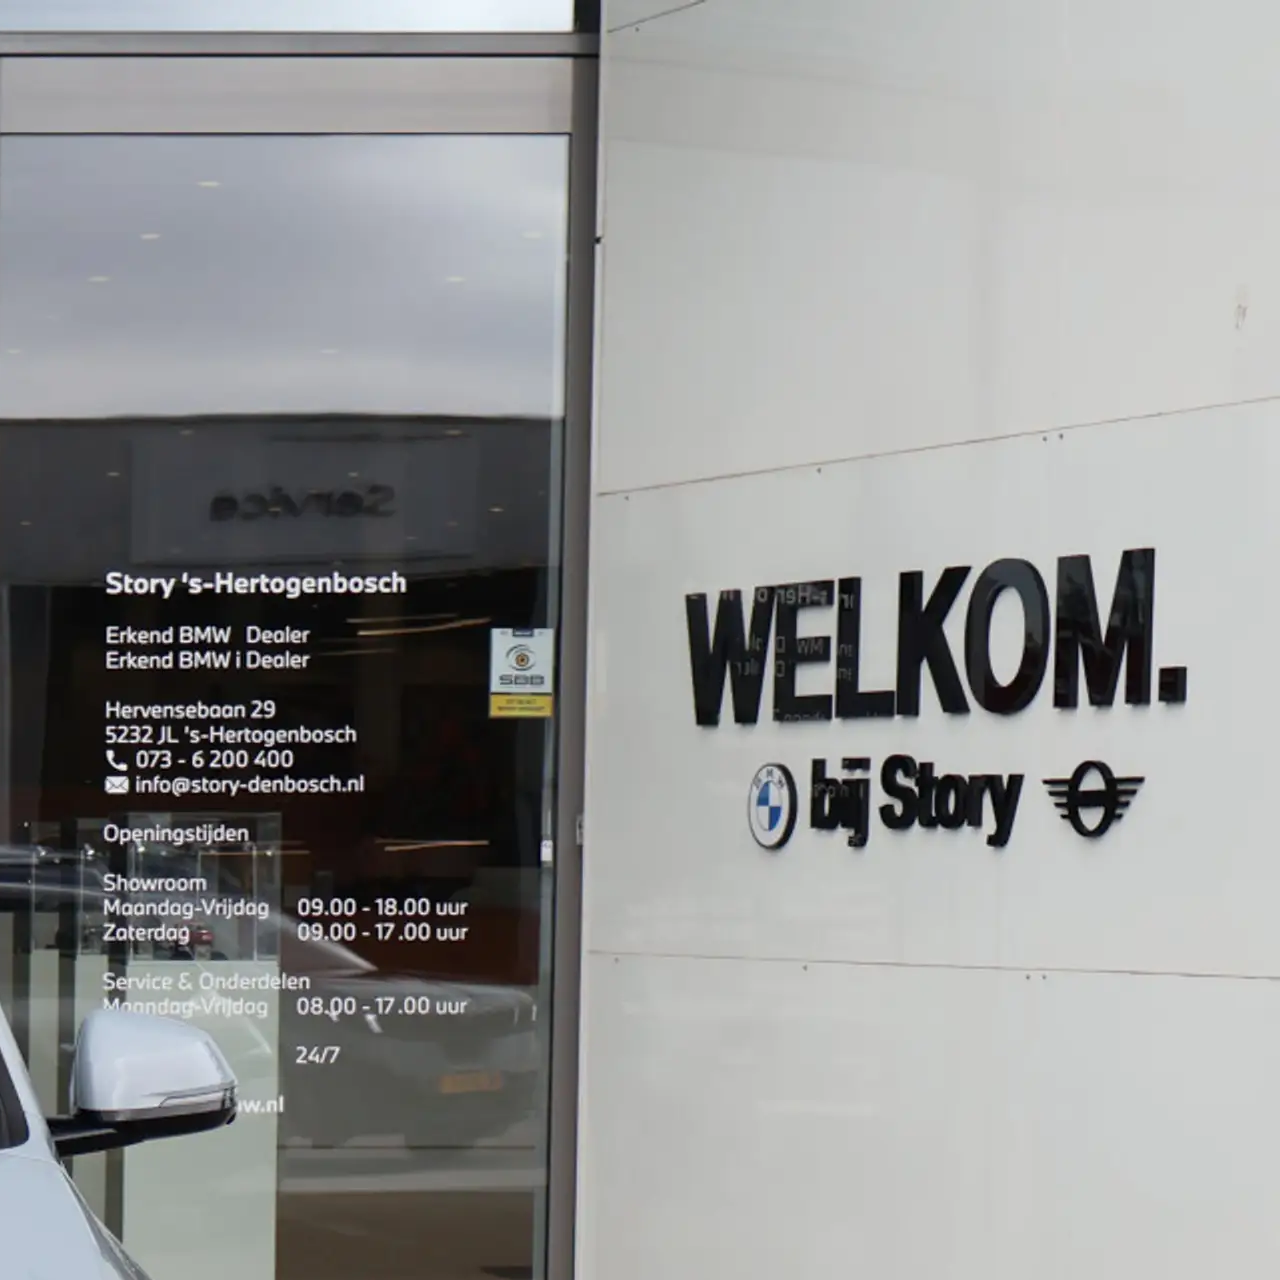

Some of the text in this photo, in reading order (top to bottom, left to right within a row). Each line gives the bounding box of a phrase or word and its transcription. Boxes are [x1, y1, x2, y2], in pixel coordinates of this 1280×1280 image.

[106, 573, 175, 598] Story
[106, 627, 309, 644] Erkend BMW Dealer
[685, 547, 1187, 727] WELKOM.
[106, 652, 309, 669] Erkend BMW i Dealer
[106, 701, 276, 719] Hervensebaan 29
[106, 727, 153, 743] 5232
[157, 727, 178, 745] JL
[136, 751, 171, 768] 073
[192, 751, 204, 768] 6
[210, 751, 248, 768] 200
[254, 751, 293, 768] 400
[135, 775, 364, 796] info@story-denbosch.nl
[879, 754, 1023, 847] Story
[104, 825, 249, 844] Openingstijden
[103, 874, 207, 892] Showroom
[103, 899, 269, 920] Maandag-Vrijdag
[298, 899, 356, 916] 09.00
[376, 899, 430, 916] 18.00
[436, 903, 468, 916] uur
[103, 925, 190, 944] Zaterdag
[298, 924, 356, 941] 09.00
[436, 928, 468, 941] uur
[103, 972, 310, 990] Service & Onderdelen
[297, 998, 356, 1015] 08.00
[436, 1002, 467, 1015] uur
[296, 1047, 340, 1064] 24/7
